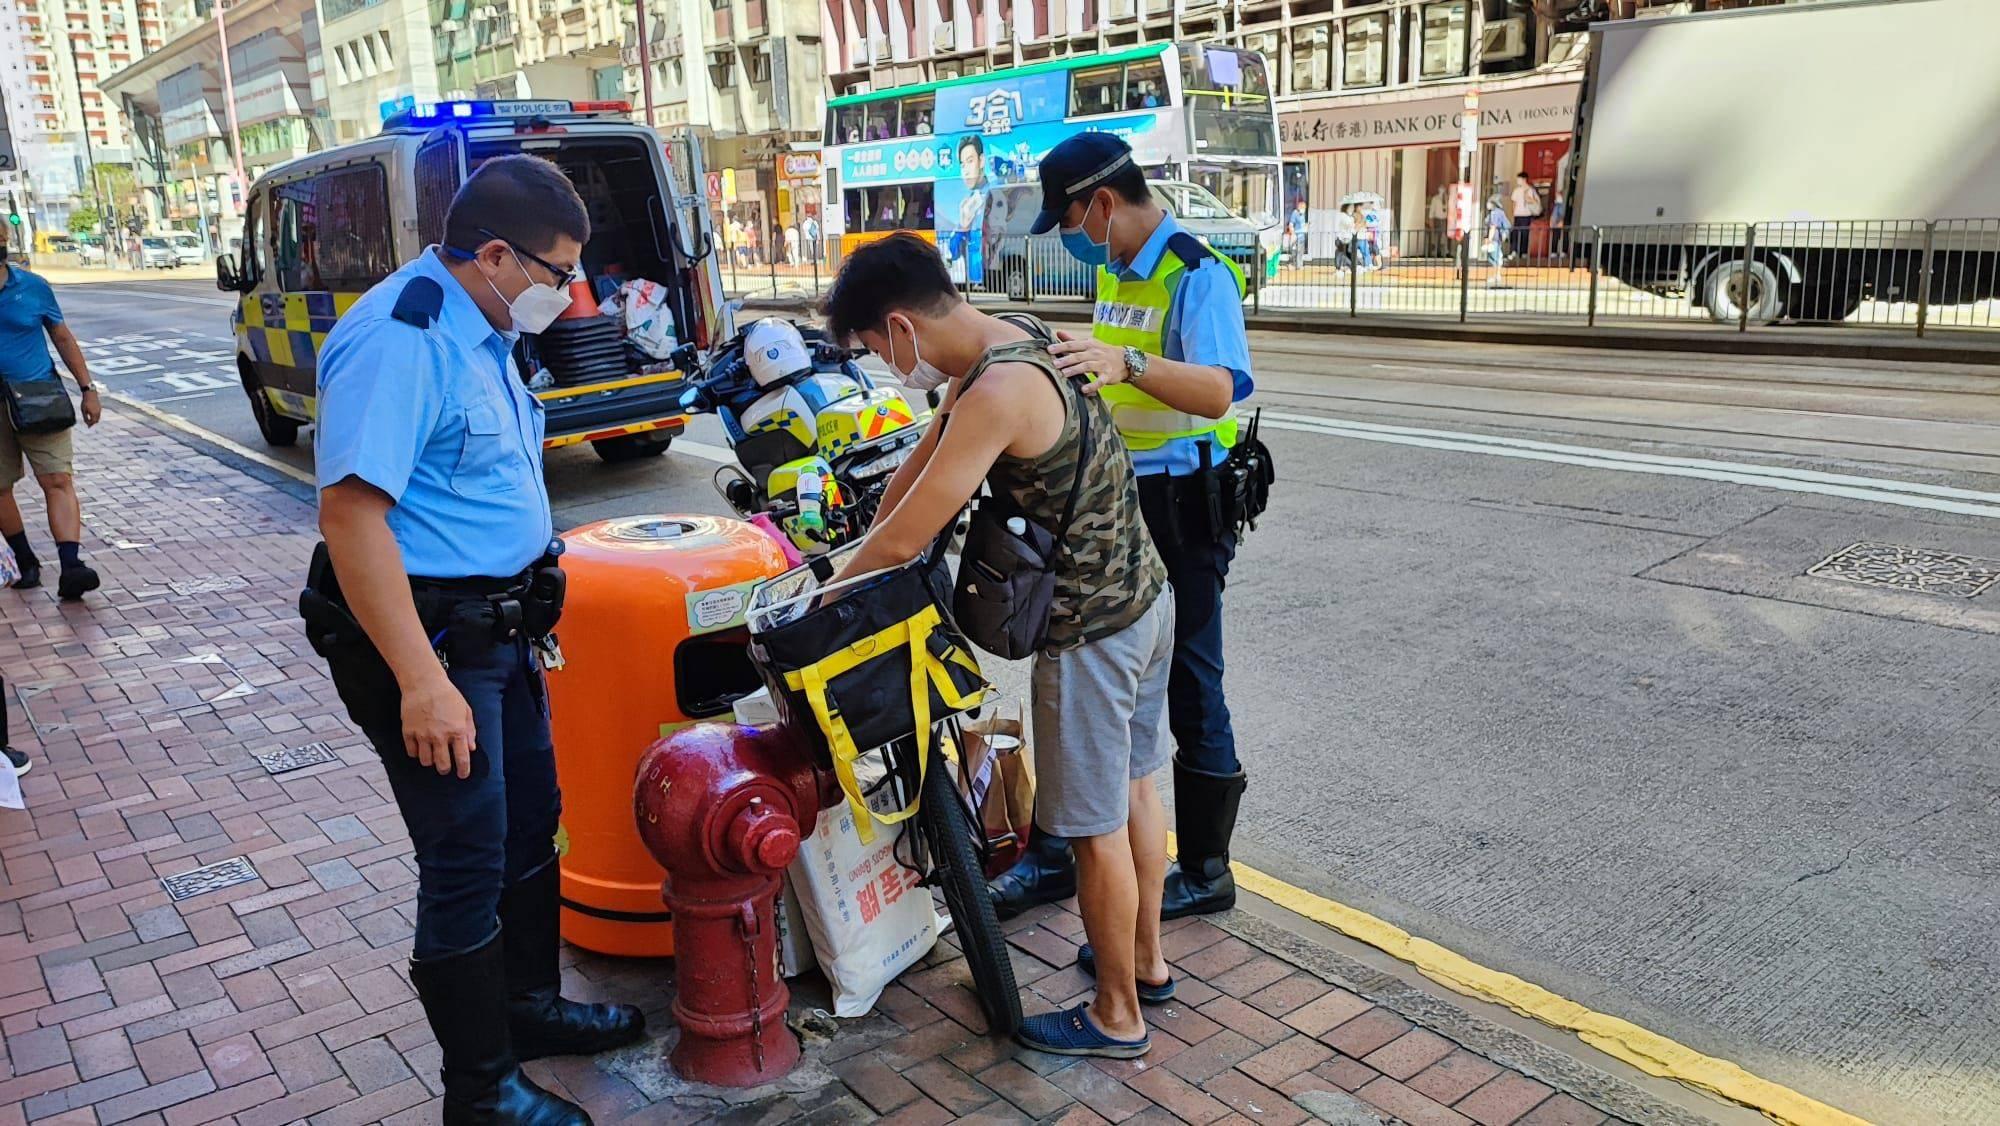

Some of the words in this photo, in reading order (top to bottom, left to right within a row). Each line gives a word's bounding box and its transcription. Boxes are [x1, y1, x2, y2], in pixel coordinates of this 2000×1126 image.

[513, 103, 552, 114] POLICE
[965, 88, 1023, 126] 3合1
[1373, 117, 1419, 135] BANK
[1424, 114, 1447, 131] OF
[1452, 108, 1512, 129] CINA
